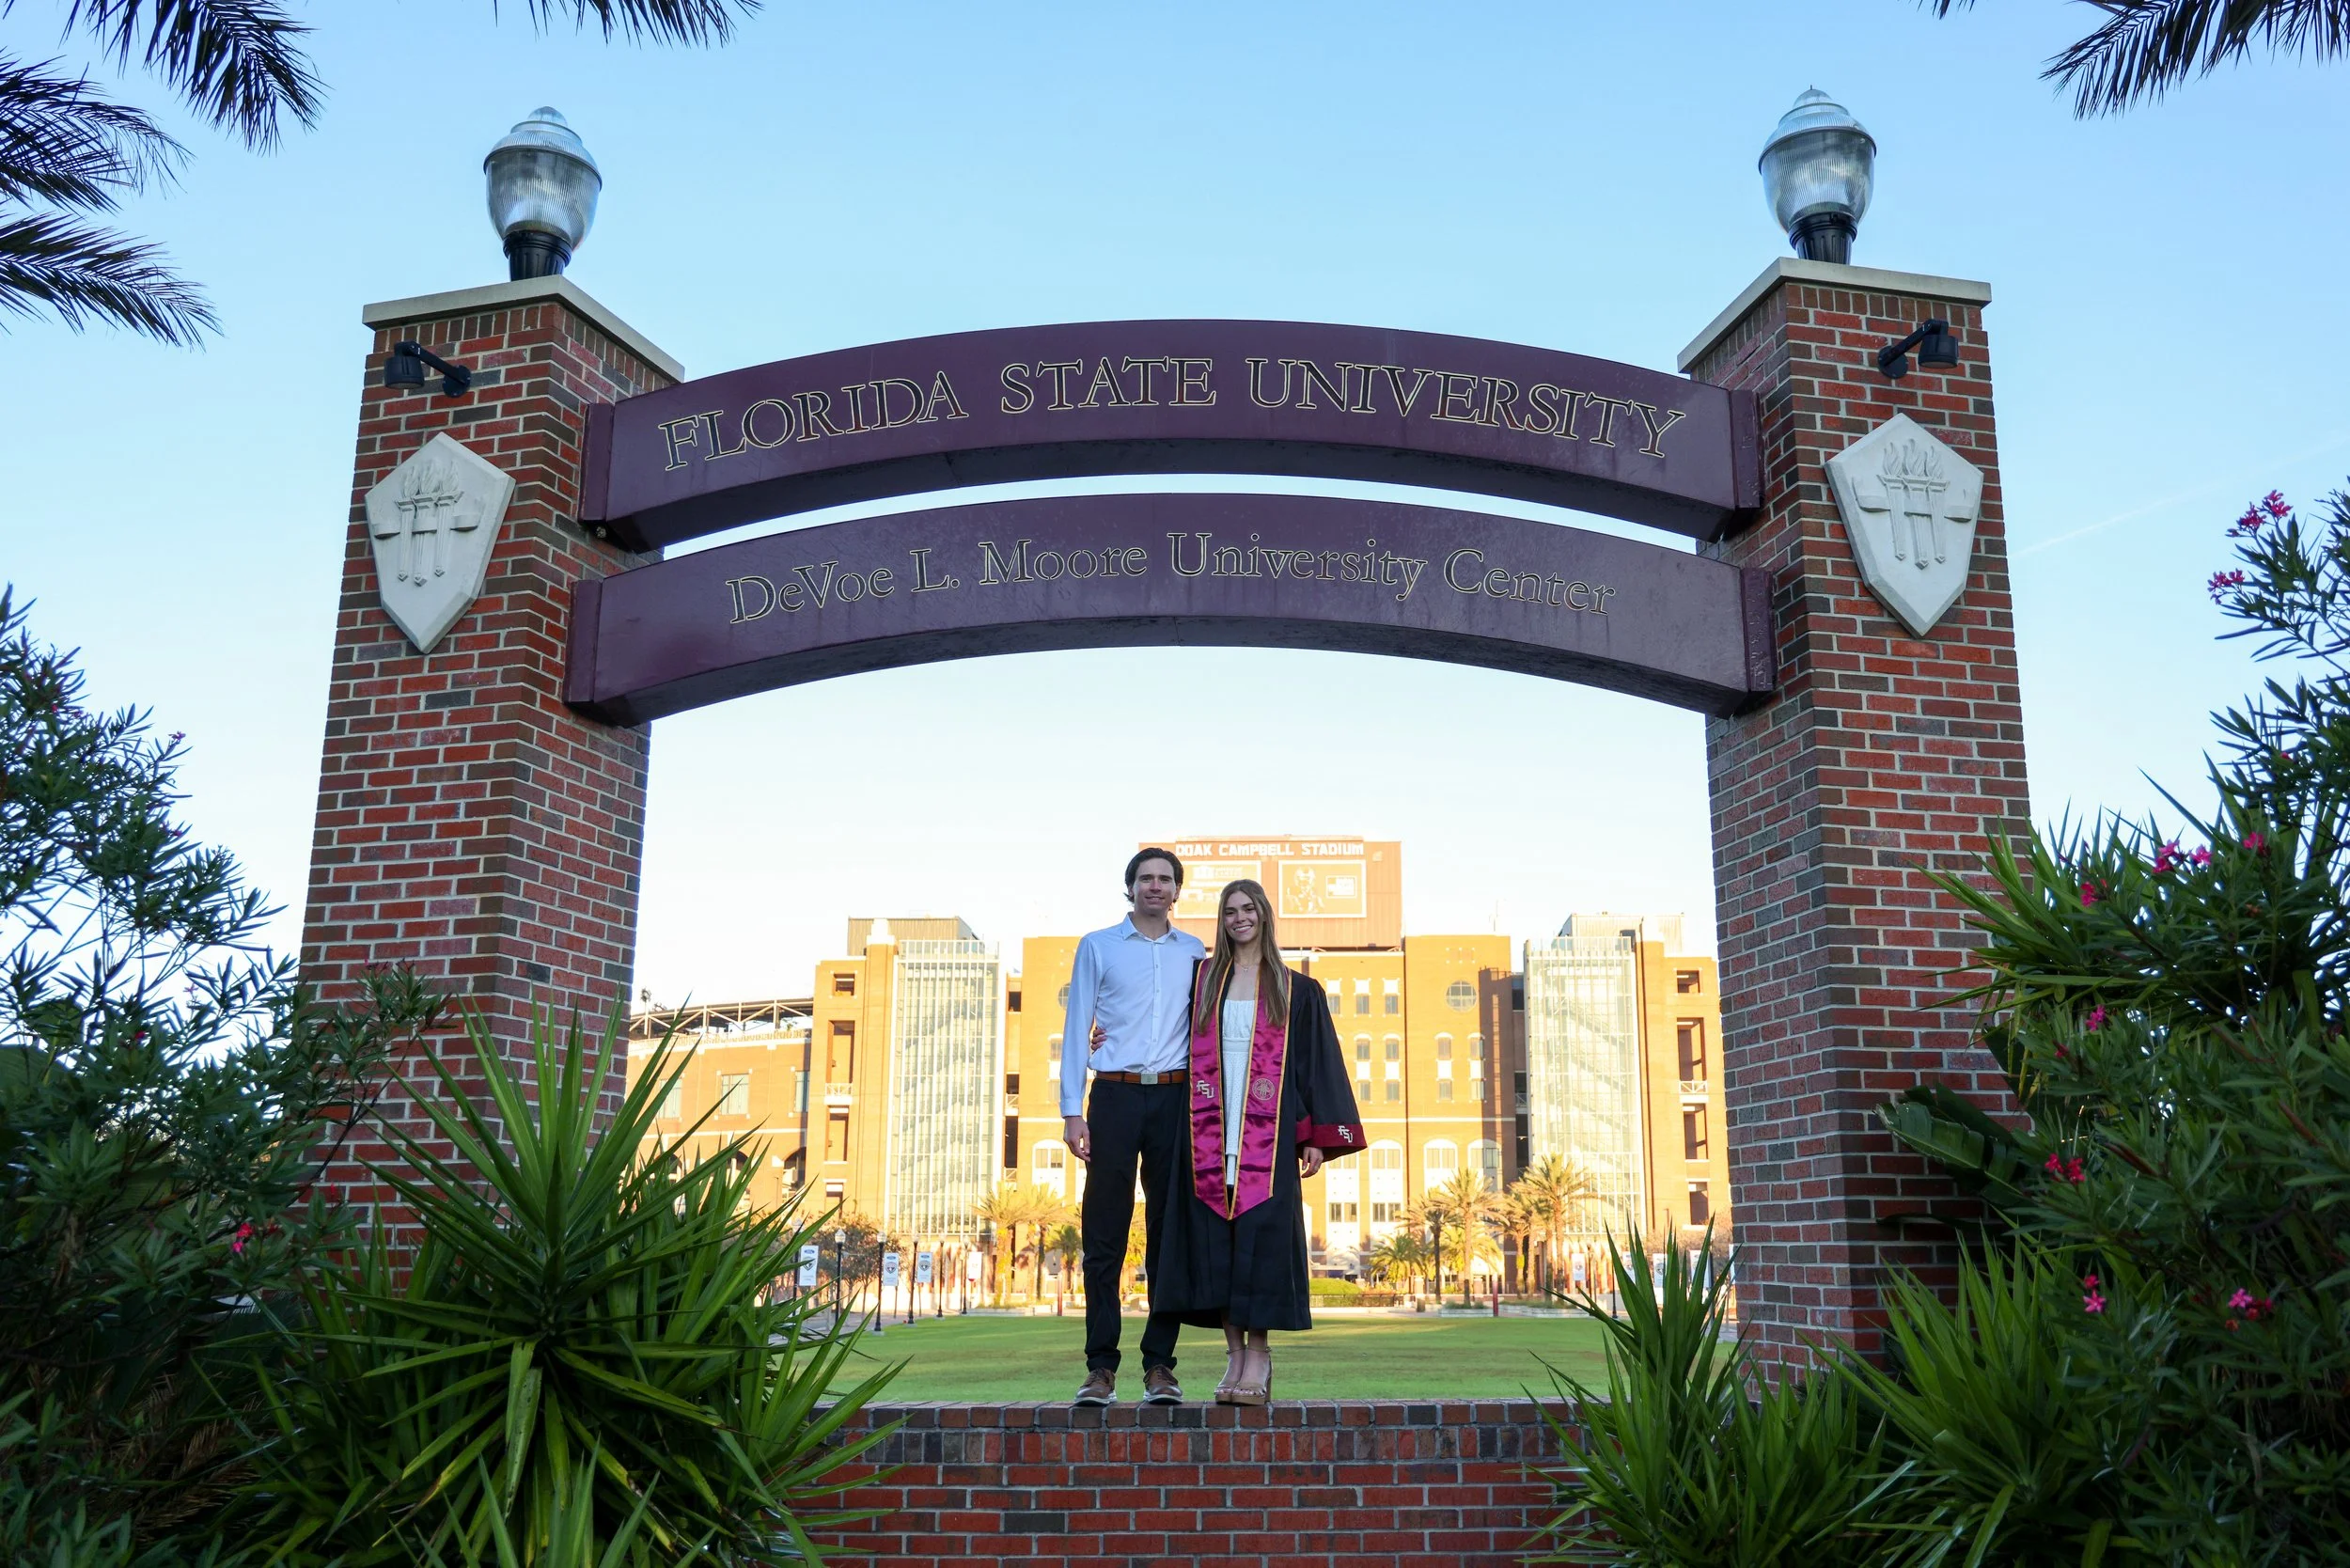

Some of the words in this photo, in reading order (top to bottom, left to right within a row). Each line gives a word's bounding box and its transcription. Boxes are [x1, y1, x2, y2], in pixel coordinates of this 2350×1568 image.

[658, 370, 969, 471] FLORIDA
[1000, 356, 1217, 415] STATE
[1246, 357, 1686, 458] UNIVERSITY
[726, 560, 895, 625] DeVoe
[909, 548, 961, 593] L.
[979, 539, 1148, 587] Moore
[1167, 532, 1429, 602] University
[1444, 548, 1616, 616] Center
[1176, 843, 1213, 856] DOAK
[1218, 843, 1294, 856] CAMPBELL
[1301, 842, 1365, 855] STADIUM
[1197, 1080, 1214, 1099] FSU
[1339, 1125, 1354, 1143] FSU
